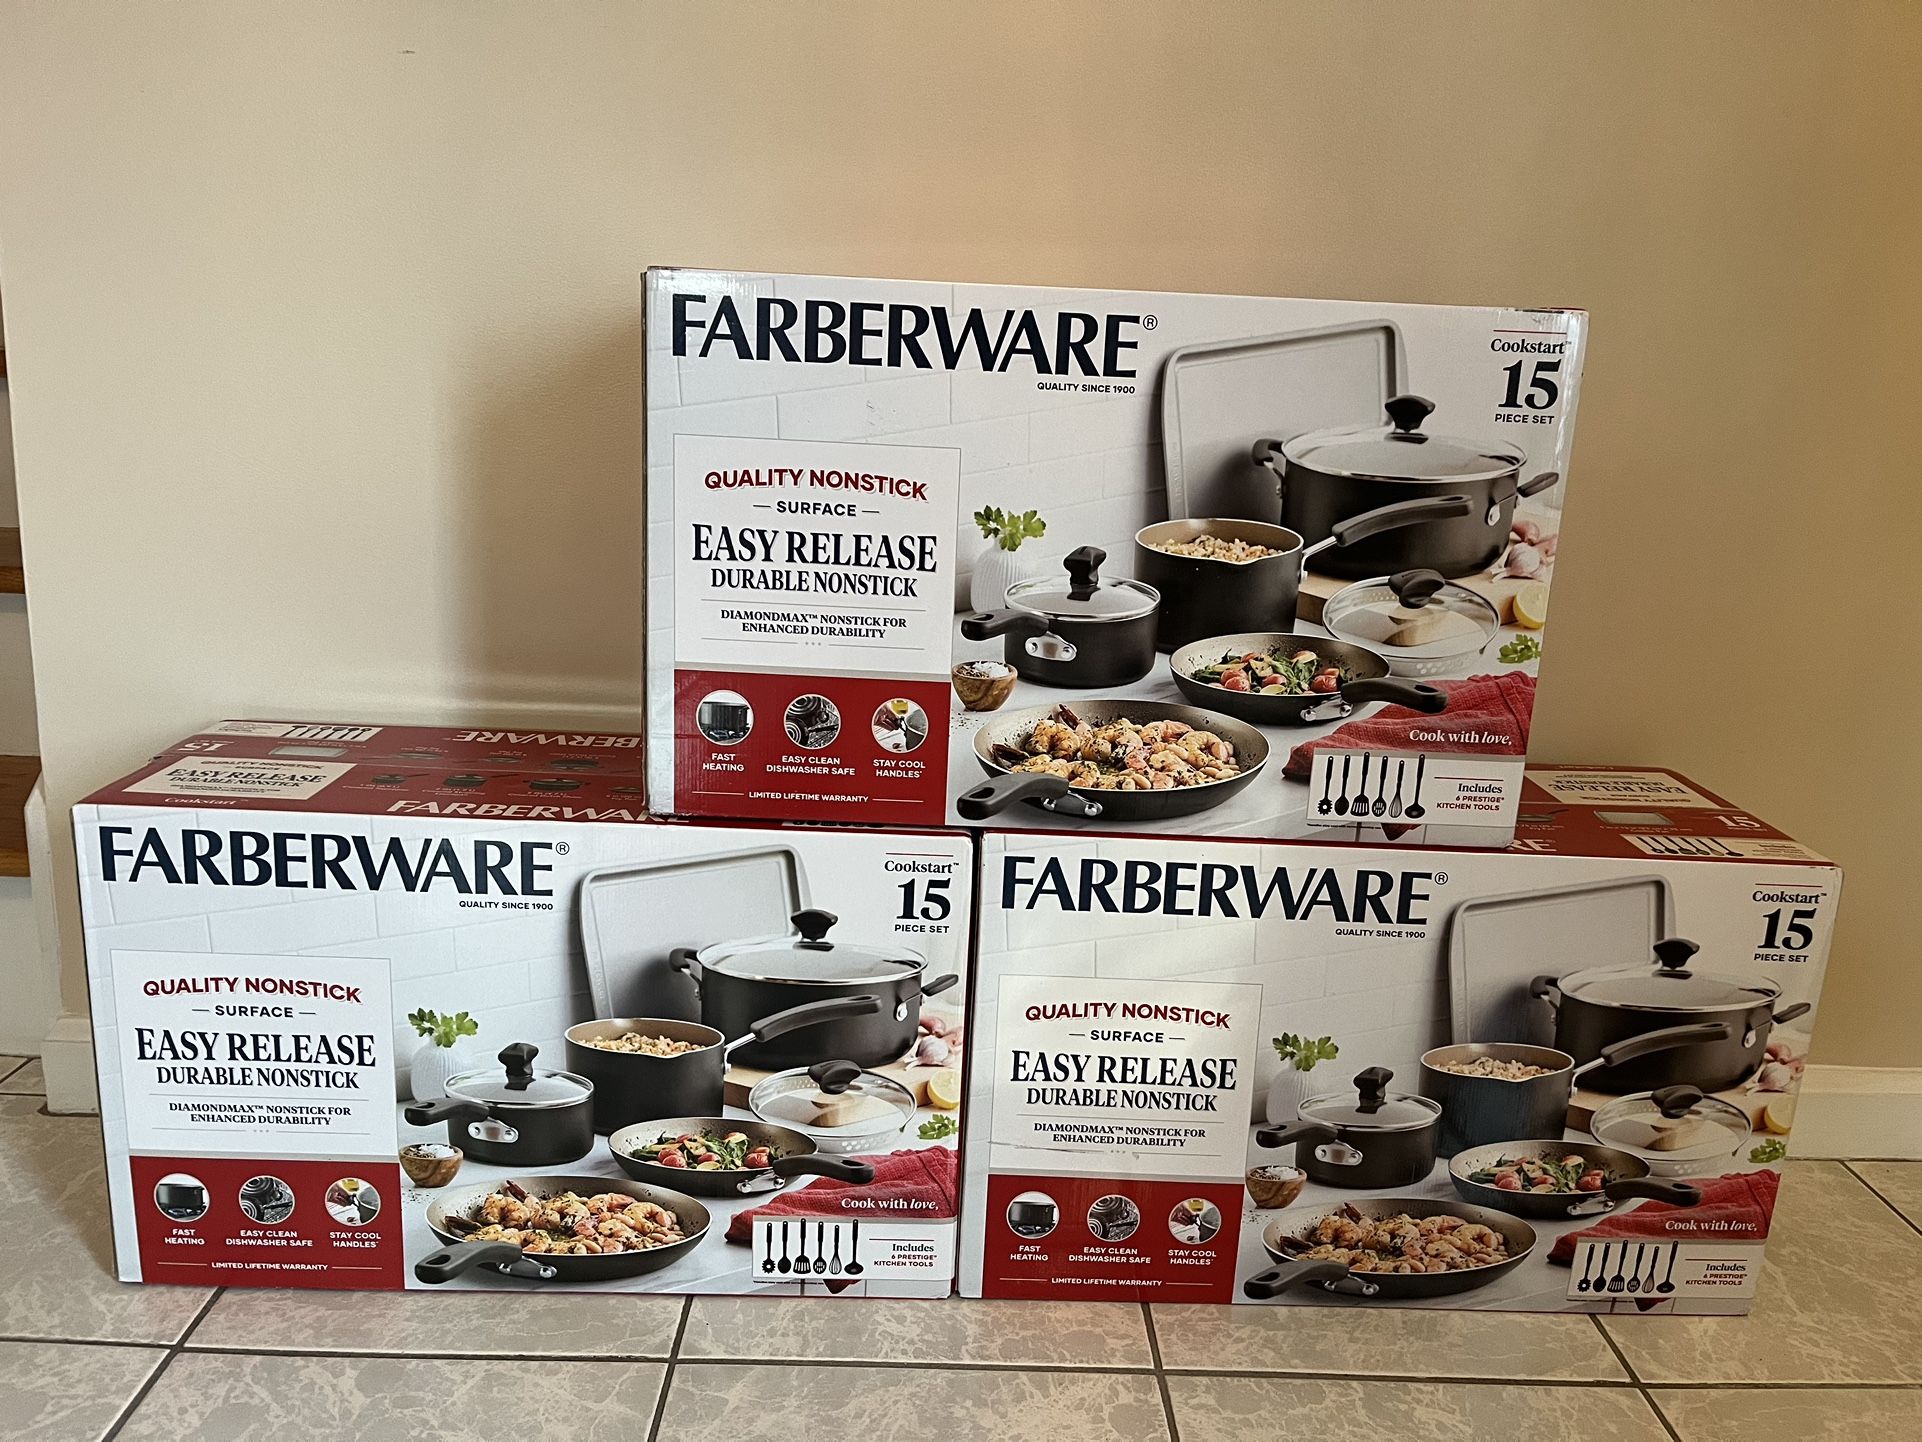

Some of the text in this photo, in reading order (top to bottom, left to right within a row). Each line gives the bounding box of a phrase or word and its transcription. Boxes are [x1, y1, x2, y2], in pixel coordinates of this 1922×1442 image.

[1037, 382, 1135, 395] QUALITY SINCE 1900
[1498, 359, 1562, 409] 15
[1495, 414, 1554, 424] PIECE SET
[705, 469, 928, 502] QUALITY NONSTICK
[776, 501, 856, 516] SURFACE
[692, 523, 937, 573] EASY RELEASE
[711, 569, 918, 597] DURABLE NONSTICK
[820, 615, 881, 626] NONSTICK
[883, 617, 907, 628] FOR
[742, 623, 886, 638] ENHANCED DURABILITY
[1409, 730, 1512, 745] Cook with love,
[712, 753, 736, 761] FAST
[782, 756, 840, 765] EASY CLEAN
[703, 763, 744, 772] HEATING
[873, 759, 925, 769] STAY COOL
[166, 769, 327, 783] EASY RELEASE
[766, 765, 855, 776] DISHWASHER SAFE
[1458, 783, 1503, 794] Includes
[749, 792, 868, 802] LIMITED LIFETIME WARRANTY
[1437, 802, 1471, 810] KITCHEN
[1714, 816, 1761, 828] 15
[459, 900, 553, 911] QUALITY SINCE 1900
[896, 878, 951, 921] 15
[895, 924, 949, 933] PIECE SET
[1335, 928, 1425, 939] QUALITY SINCE 1900
[1758, 908, 1817, 950] 15
[143, 977, 361, 1002] QUALITY NONSTICK
[215, 1005, 293, 1018] SURFACE
[1025, 1002, 1231, 1029] QUALITY NONSTICK
[1090, 1030, 1164, 1043] SURFACE
[135, 1028, 376, 1067] EASY RELEASE
[1011, 1050, 1238, 1090] EASY RELEASE
[157, 1066, 360, 1089] DURABLE NONSTICK
[1026, 1088, 1218, 1111] DURABLE NONSTICK
[266, 1106, 326, 1115] NONSTICK
[328, 1107, 351, 1116] FOR
[190, 1113, 331, 1125] ENHANCED DURABILITY
[1126, 1126, 1182, 1137] NONSTICK
[1183, 1129, 1206, 1138] FOR
[1053, 1134, 1186, 1147] ENHANCED DURABILITY
[841, 1198, 939, 1210] Cook with love,
[172, 1228, 195, 1236] FAST
[1665, 1220, 1757, 1232] Cook with love,
[165, 1237, 205, 1245] HEATING
[330, 1231, 352, 1239] STAY
[226, 1238, 313, 1247] DISHWASHER SAFE
[892, 1243, 934, 1252] Includes
[1010, 1253, 1048, 1261] HEATING
[1108, 1247, 1137, 1255] CLEAN
[1168, 1249, 1190, 1257] STAY
[1068, 1254, 1151, 1264] DISHWASHER SAFE
[1706, 1263, 1746, 1272] Includes
